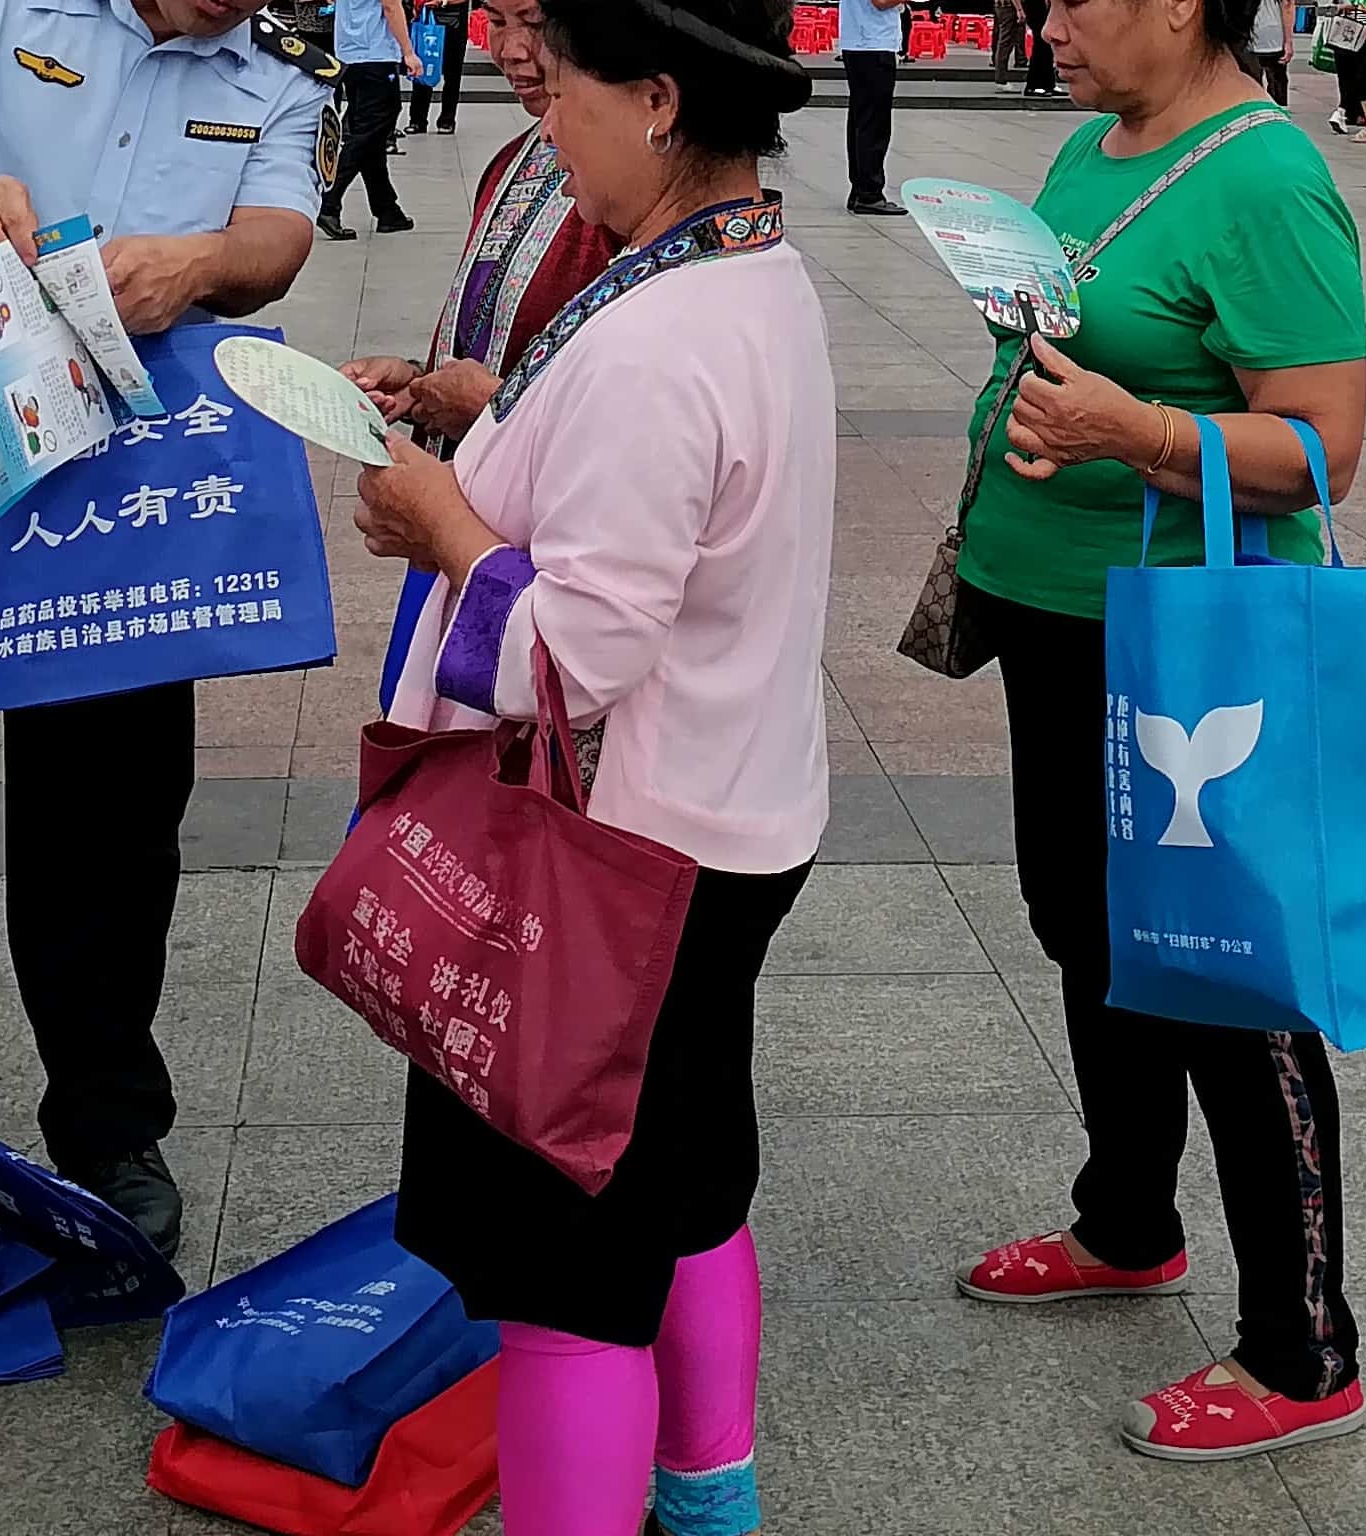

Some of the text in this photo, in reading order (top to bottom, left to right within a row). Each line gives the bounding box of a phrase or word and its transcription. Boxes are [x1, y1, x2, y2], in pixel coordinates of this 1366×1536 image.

[11, 474, 245, 552] 人人有责
[352, 886, 512, 1033] 重安全 讲礼仪
